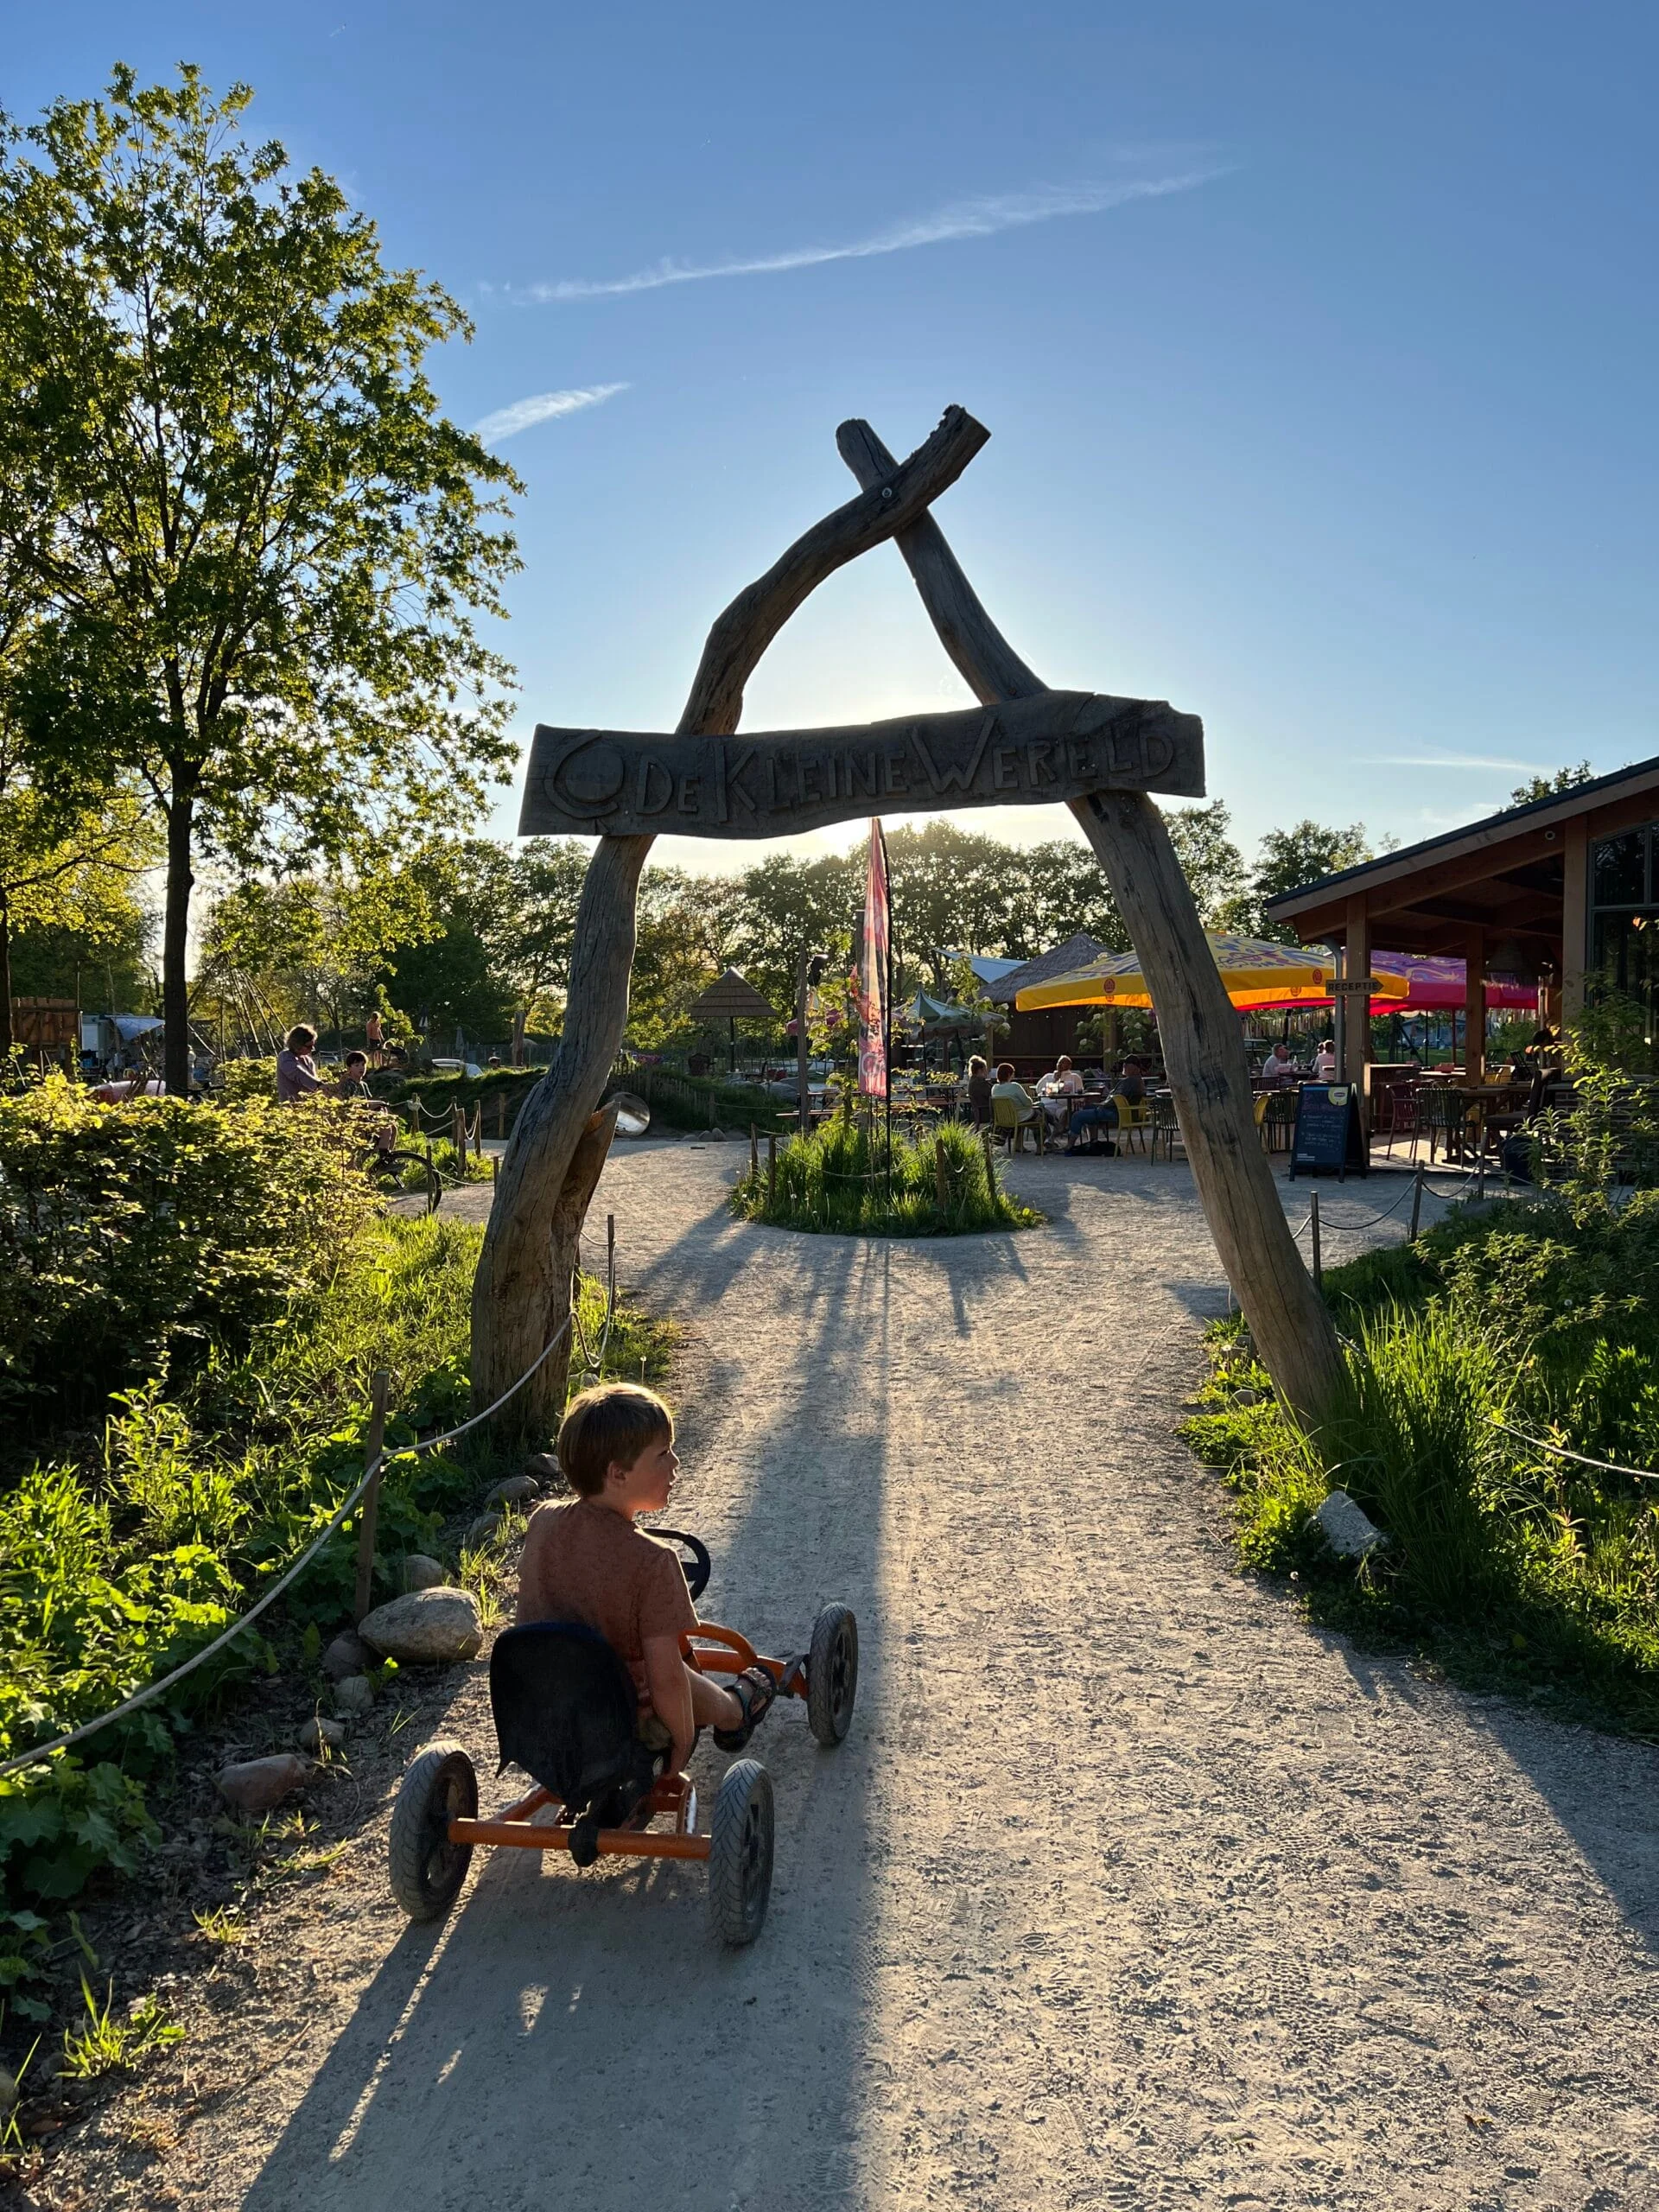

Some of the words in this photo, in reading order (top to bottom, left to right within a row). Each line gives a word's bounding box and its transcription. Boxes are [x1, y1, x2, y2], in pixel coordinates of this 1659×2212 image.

[635, 750, 700, 815] DE
[713, 742, 909, 823] KLEINE
[907, 713, 1175, 796] WERELD
[1328, 982, 1379, 992] RECEPTIE
